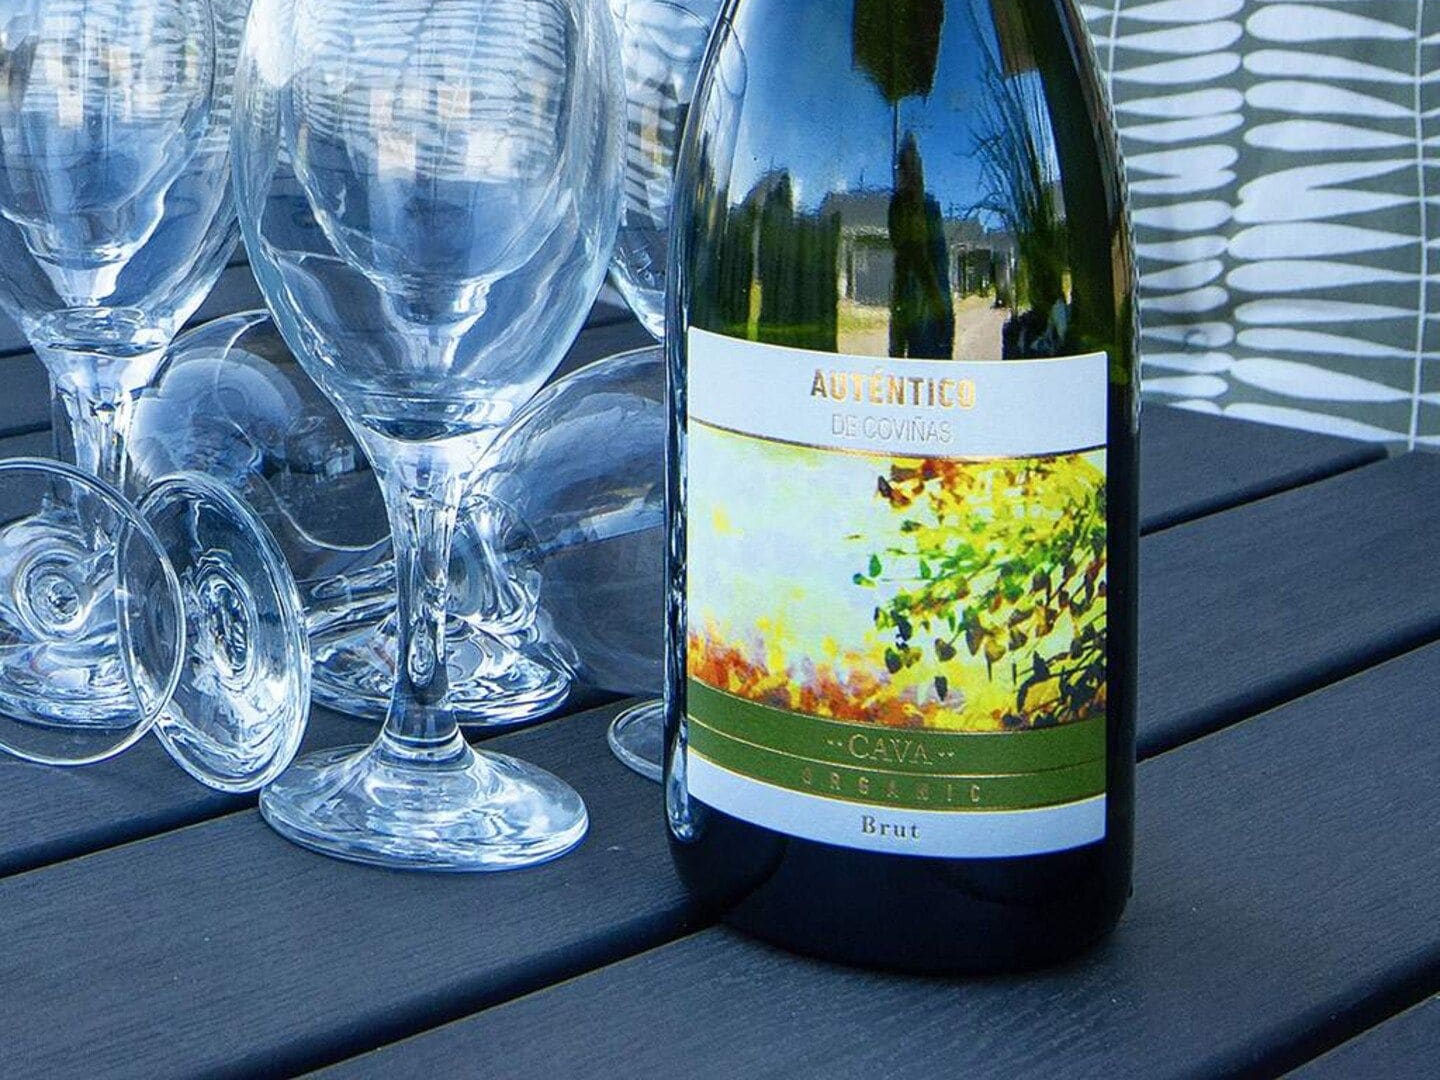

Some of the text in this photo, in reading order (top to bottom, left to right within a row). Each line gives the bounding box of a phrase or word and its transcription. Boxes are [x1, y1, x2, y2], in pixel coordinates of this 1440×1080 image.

[811, 366, 974, 409] AUTÉNTICO
[831, 414, 952, 444] DE COVIÑAS
[848, 733, 933, 766] CAVA
[861, 814, 921, 840] Brut
